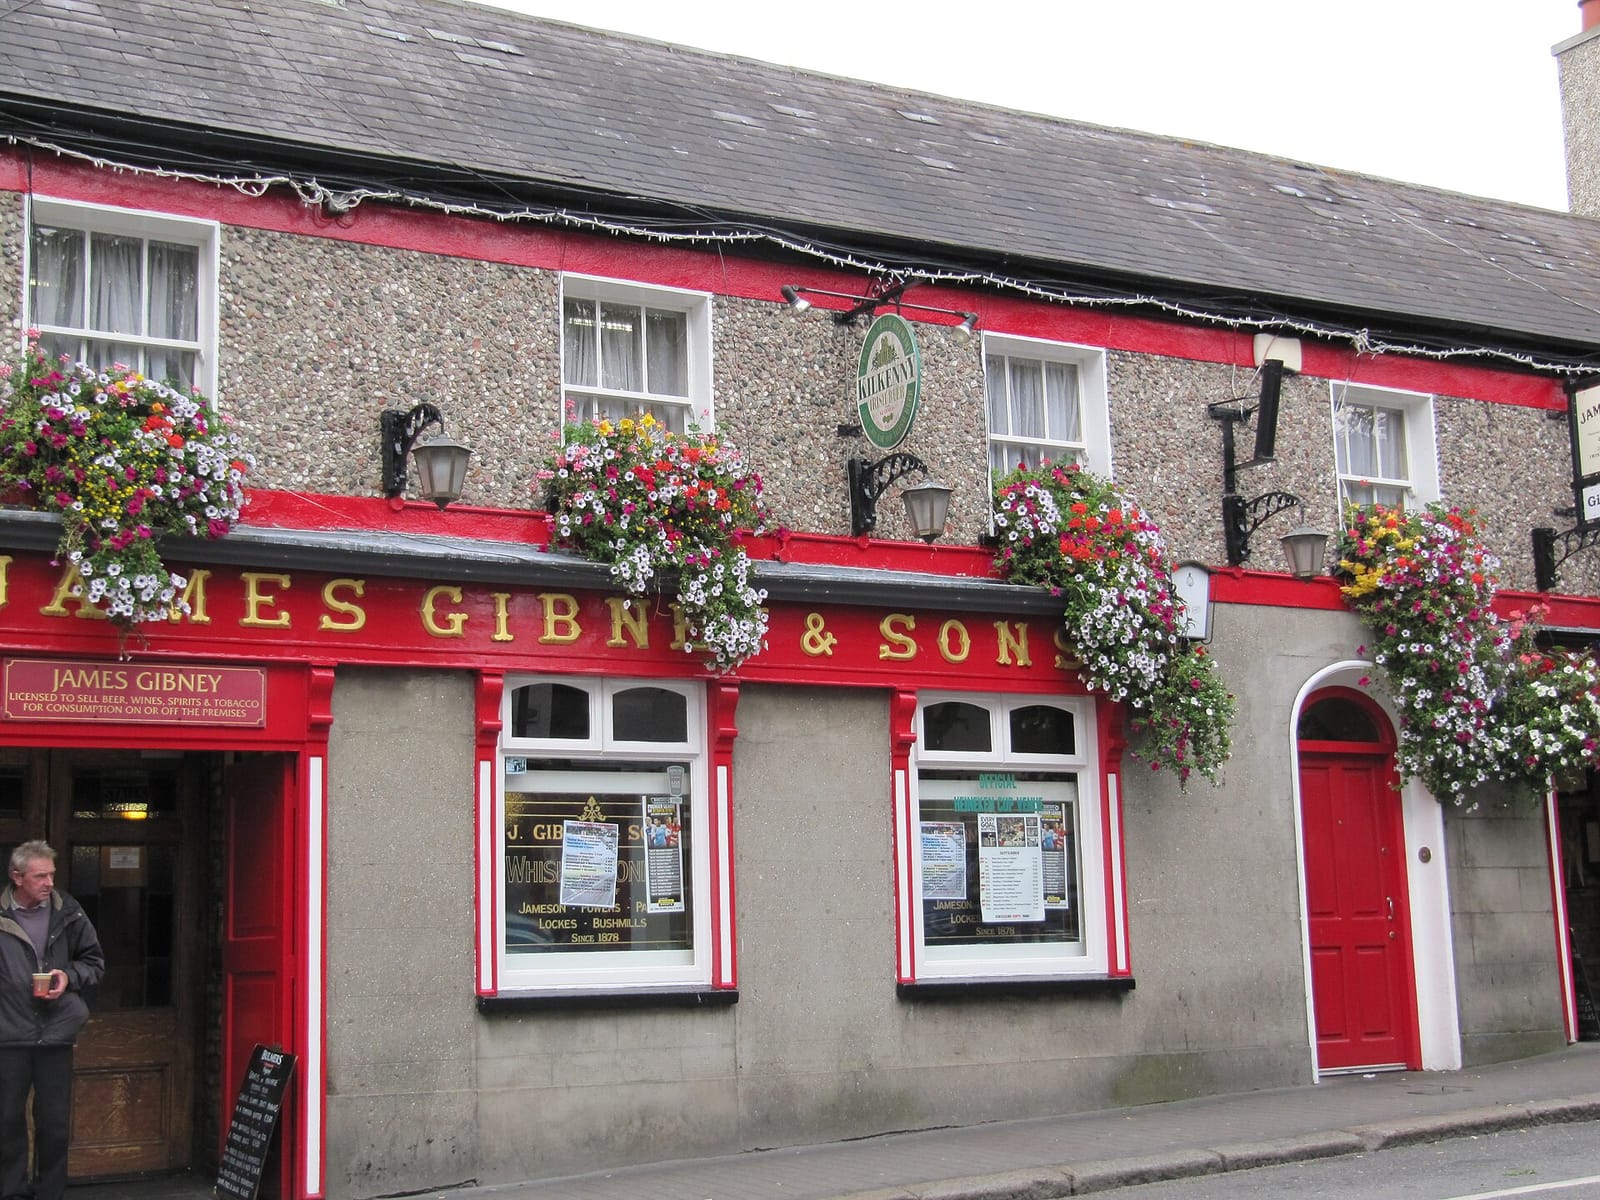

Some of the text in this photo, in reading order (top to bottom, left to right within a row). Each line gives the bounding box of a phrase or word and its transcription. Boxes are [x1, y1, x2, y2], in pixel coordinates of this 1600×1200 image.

[859, 355, 915, 401] KILKENNY
[1580, 403, 1600, 425] JAM
[1587, 494, 1600, 507] Gi
[420, 585, 769, 650] GIBNE
[801, 612, 837, 656] &
[53, 668, 223, 693] JAMES GIBNEY
[9, 692, 58, 702] LICENSED
[61, 694, 75, 703] TO
[78, 694, 99, 703] SELL
[131, 696, 164, 706] WINES,
[168, 697, 201, 707] SPIRITS
[204, 699, 211, 708] &
[214, 698, 260, 709] TOBACCO
[23, 703, 247, 718] FOR CONSUMPTION ON OR OFF THE PREMISES
[507, 824, 563, 841] J. GIB
[518, 901, 567, 914] JAMESON
[933, 900, 973, 910] JAMESON
[539, 918, 648, 929] LOCKES BUSHMILLS
[950, 913, 981, 924] LOCKE
[598, 932, 619, 943] 1878
[998, 926, 1015, 936] 1878
